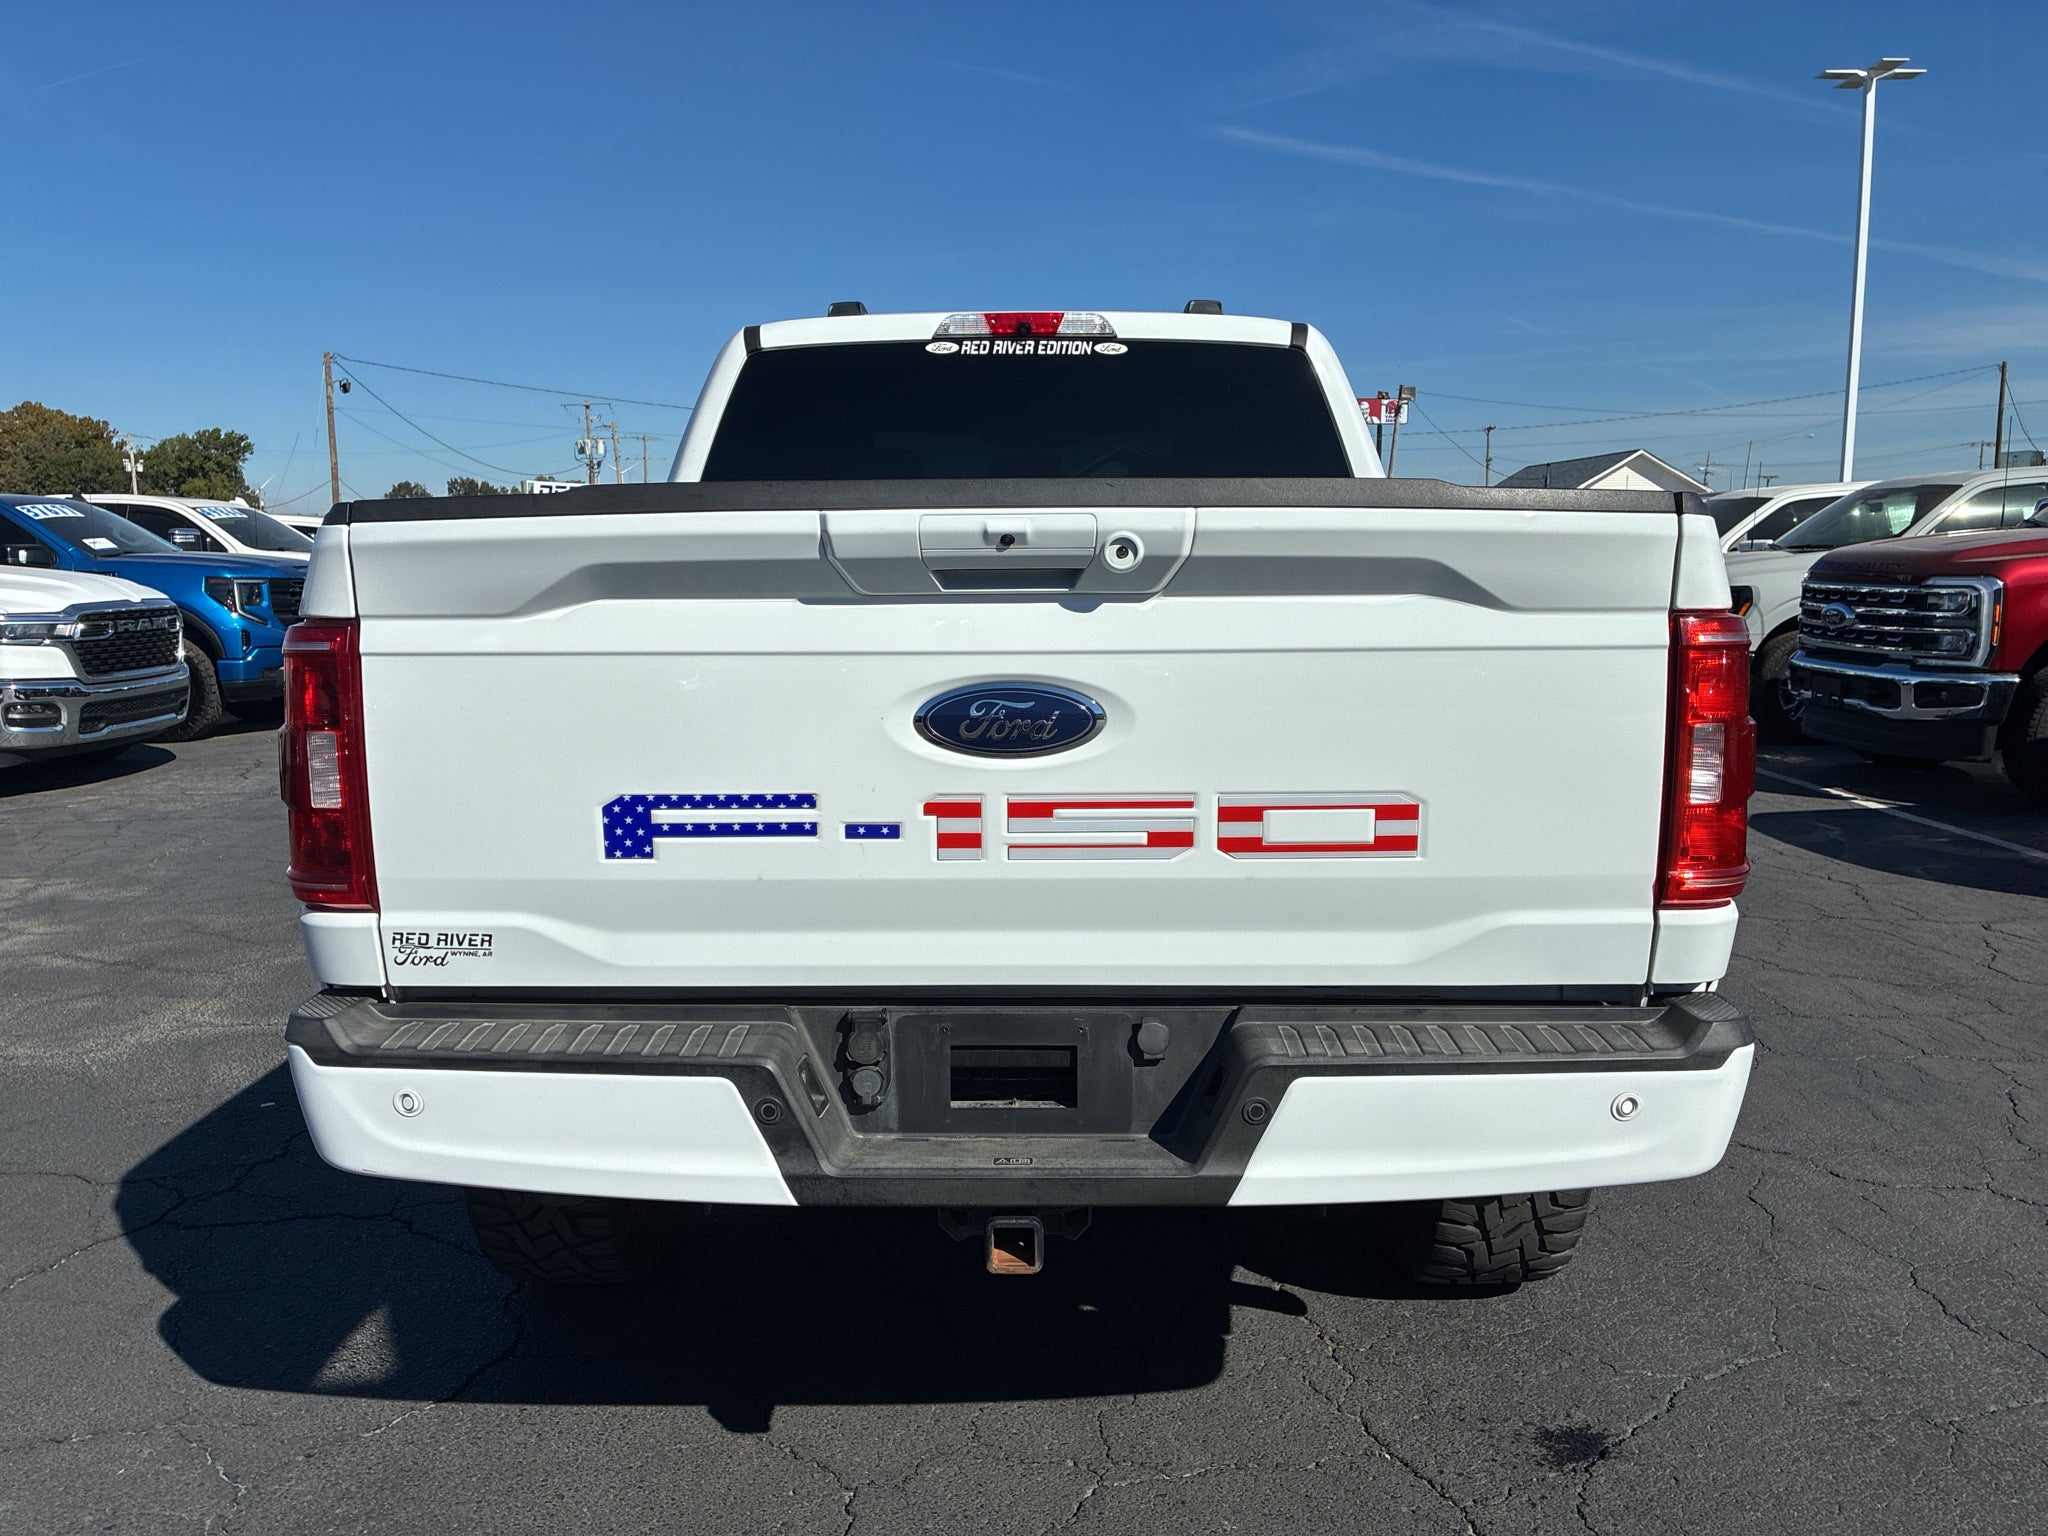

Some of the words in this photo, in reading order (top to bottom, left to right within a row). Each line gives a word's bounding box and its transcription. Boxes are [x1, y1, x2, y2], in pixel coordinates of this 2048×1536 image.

[931, 343, 954, 353] Ford
[961, 341, 990, 355] RED
[992, 341, 1034, 355] RIVER
[1038, 341, 1093, 355] EDITION
[1099, 343, 1122, 353] Ford
[118, 617, 168, 632] RAM
[959, 699, 1058, 741] Ford
[601, 793, 1421, 861] F-150
[392, 932, 430, 946] RED
[436, 933, 493, 947] RIVER
[394, 945, 449, 967] Ford
[450, 950, 481, 958] WYNNE,
